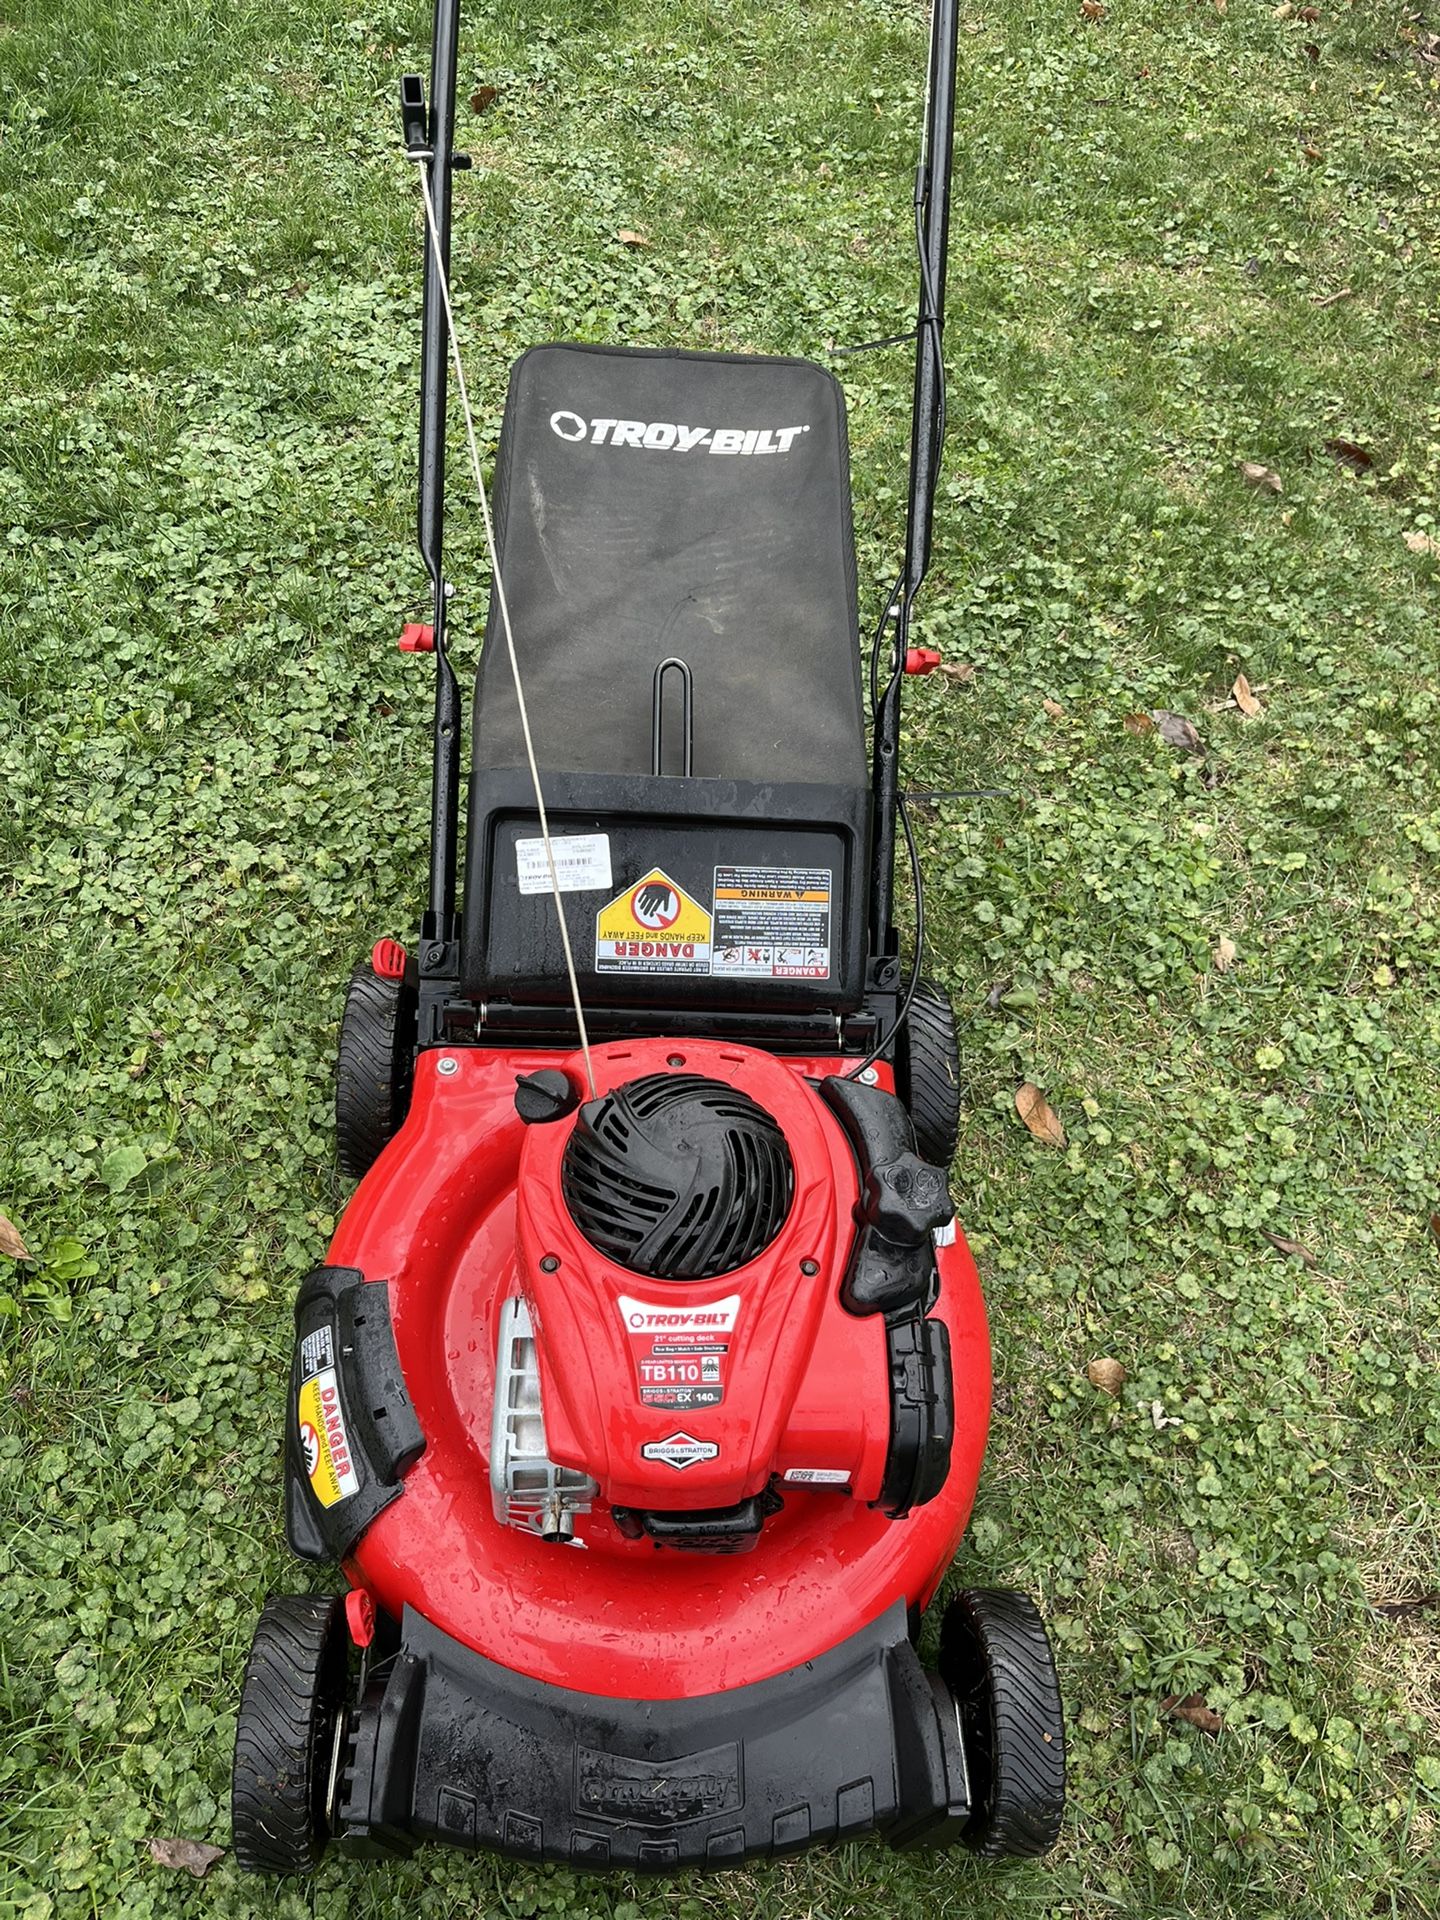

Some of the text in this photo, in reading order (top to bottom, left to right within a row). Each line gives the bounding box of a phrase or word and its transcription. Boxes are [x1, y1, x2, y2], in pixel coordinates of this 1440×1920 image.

[590, 418, 803, 455] TROY-BILT
[741, 889, 791, 899] WARNING
[602, 930, 706, 942] KEEP HANDS and FEET AWAY
[614, 941, 695, 958] DANGER
[775, 966, 816, 976] DANGER
[645, 1313, 730, 1327] TROY-BILT
[668, 1335, 696, 1344] cutting
[696, 1334, 716, 1343] deck
[640, 1365, 699, 1381] TB110
[312, 1382, 341, 1497] KEEP HANDS and FEET AWAY
[321, 1386, 351, 1479] DANGER
[648, 1447, 675, 1455] BRIGGS
[680, 1446, 713, 1455] STRATTON
